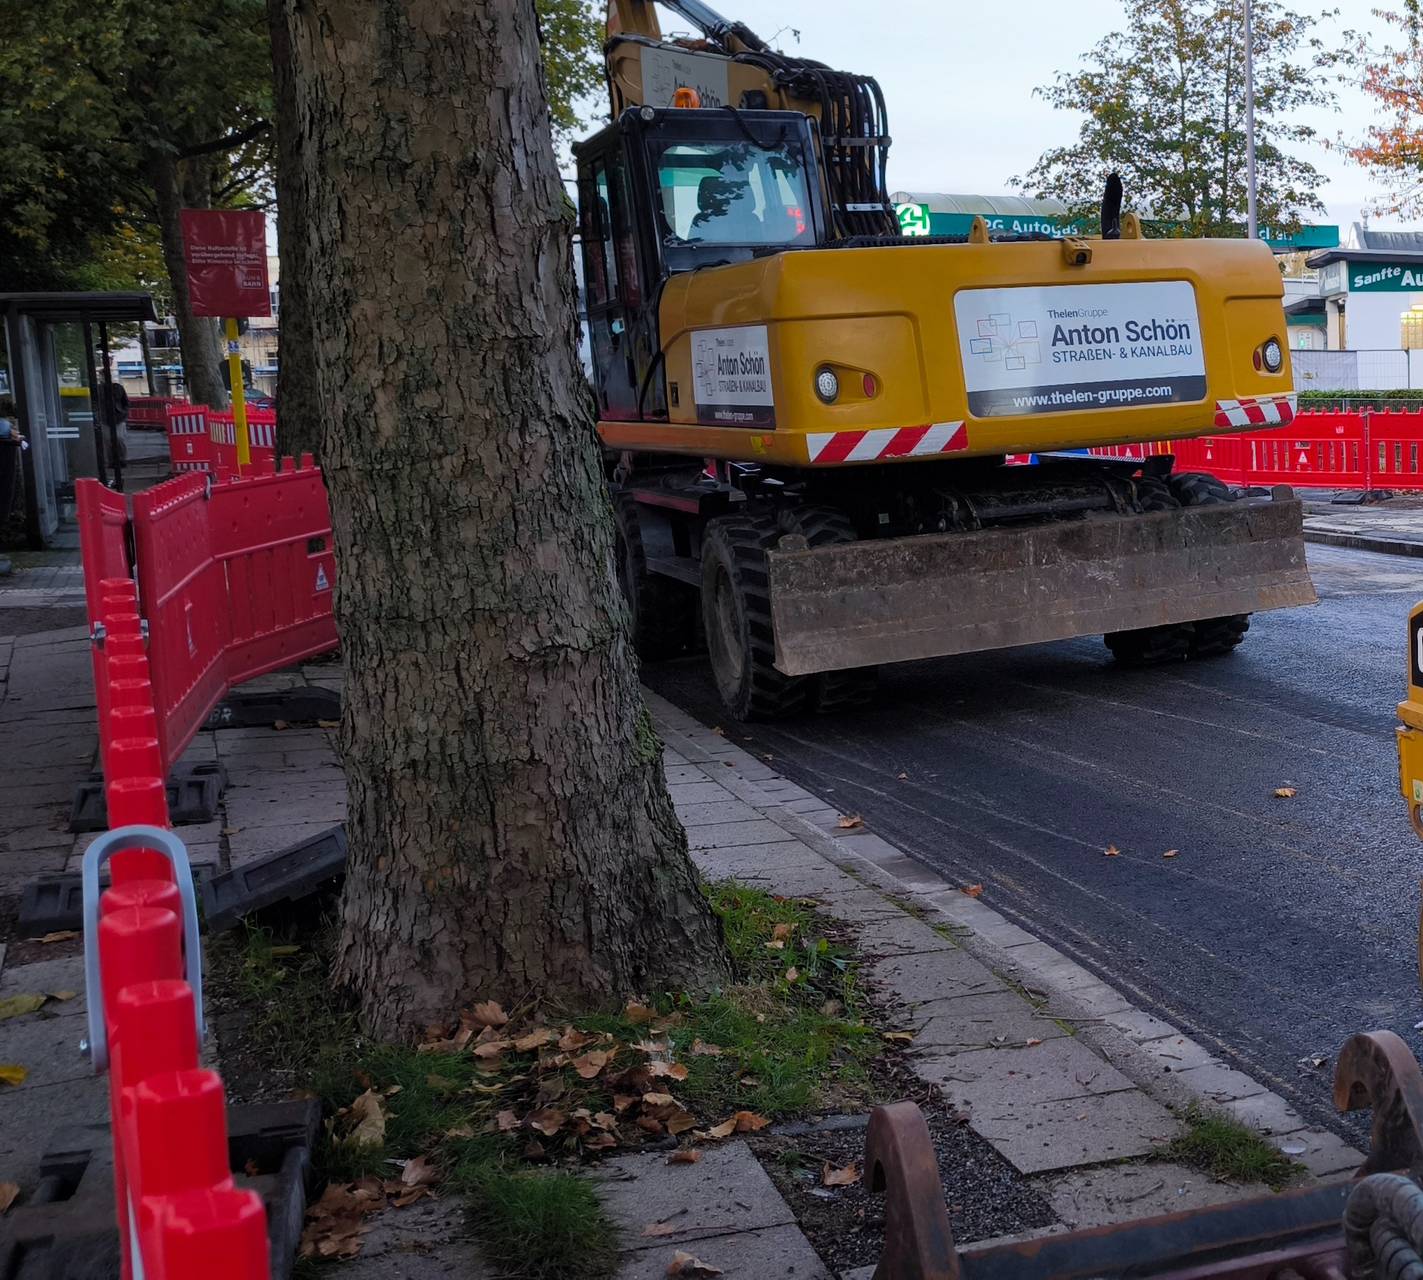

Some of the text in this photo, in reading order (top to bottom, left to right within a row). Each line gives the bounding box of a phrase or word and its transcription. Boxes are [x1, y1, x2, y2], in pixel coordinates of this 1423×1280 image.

[984, 219, 1004, 231] PG
[1354, 266, 1401, 288] Sanfte
[1047, 308, 1109, 319] ThelenGruppe
[1051, 319, 1190, 347] Anton Schön
[718, 351, 765, 375] Anton Schön
[1120, 346, 1128, 360] &
[1131, 344, 1193, 359] KANALBAU
[1013, 384, 1172, 408] www.thelen-gruppe.com
